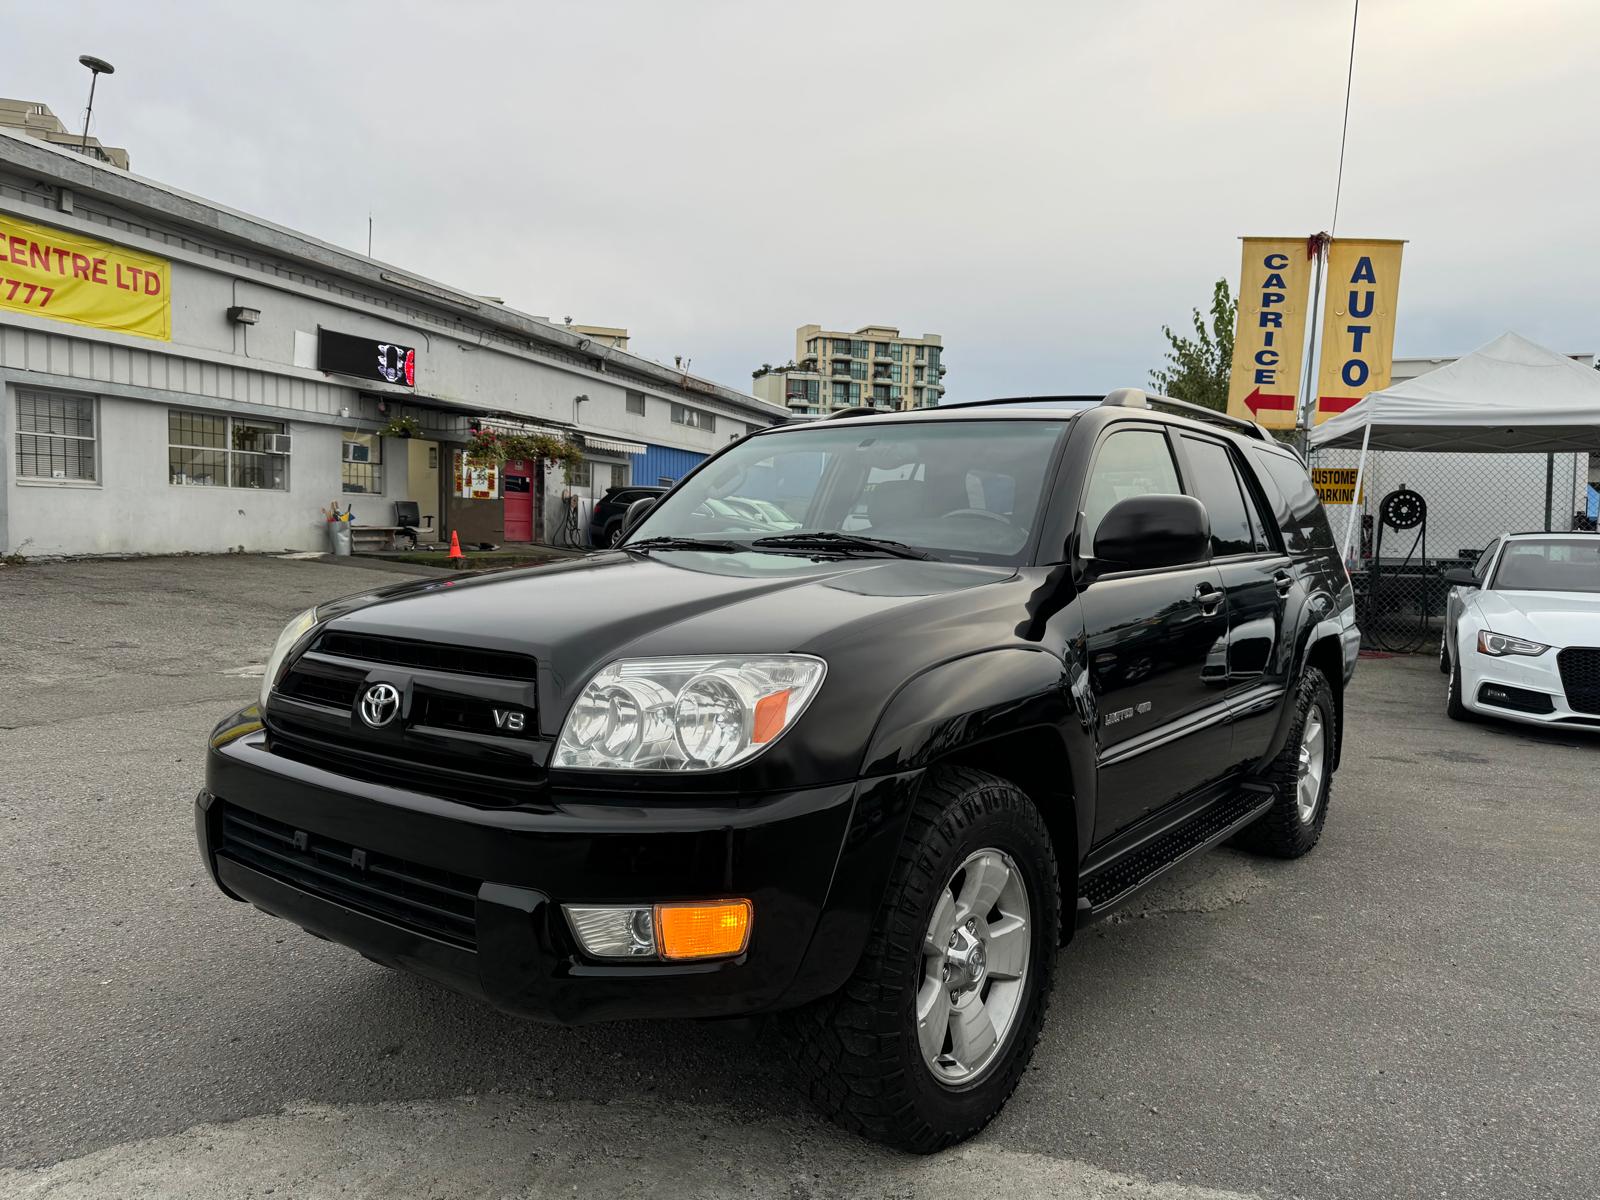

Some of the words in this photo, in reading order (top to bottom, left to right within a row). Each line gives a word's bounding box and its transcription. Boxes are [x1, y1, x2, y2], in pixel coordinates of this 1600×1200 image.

[116, 263, 161, 296] LTD
[1254, 253, 1289, 384] CAPRICE
[1341, 256, 1377, 387] AUTO
[1312, 470, 1358, 485] USTOME
[493, 709, 525, 731] V8
